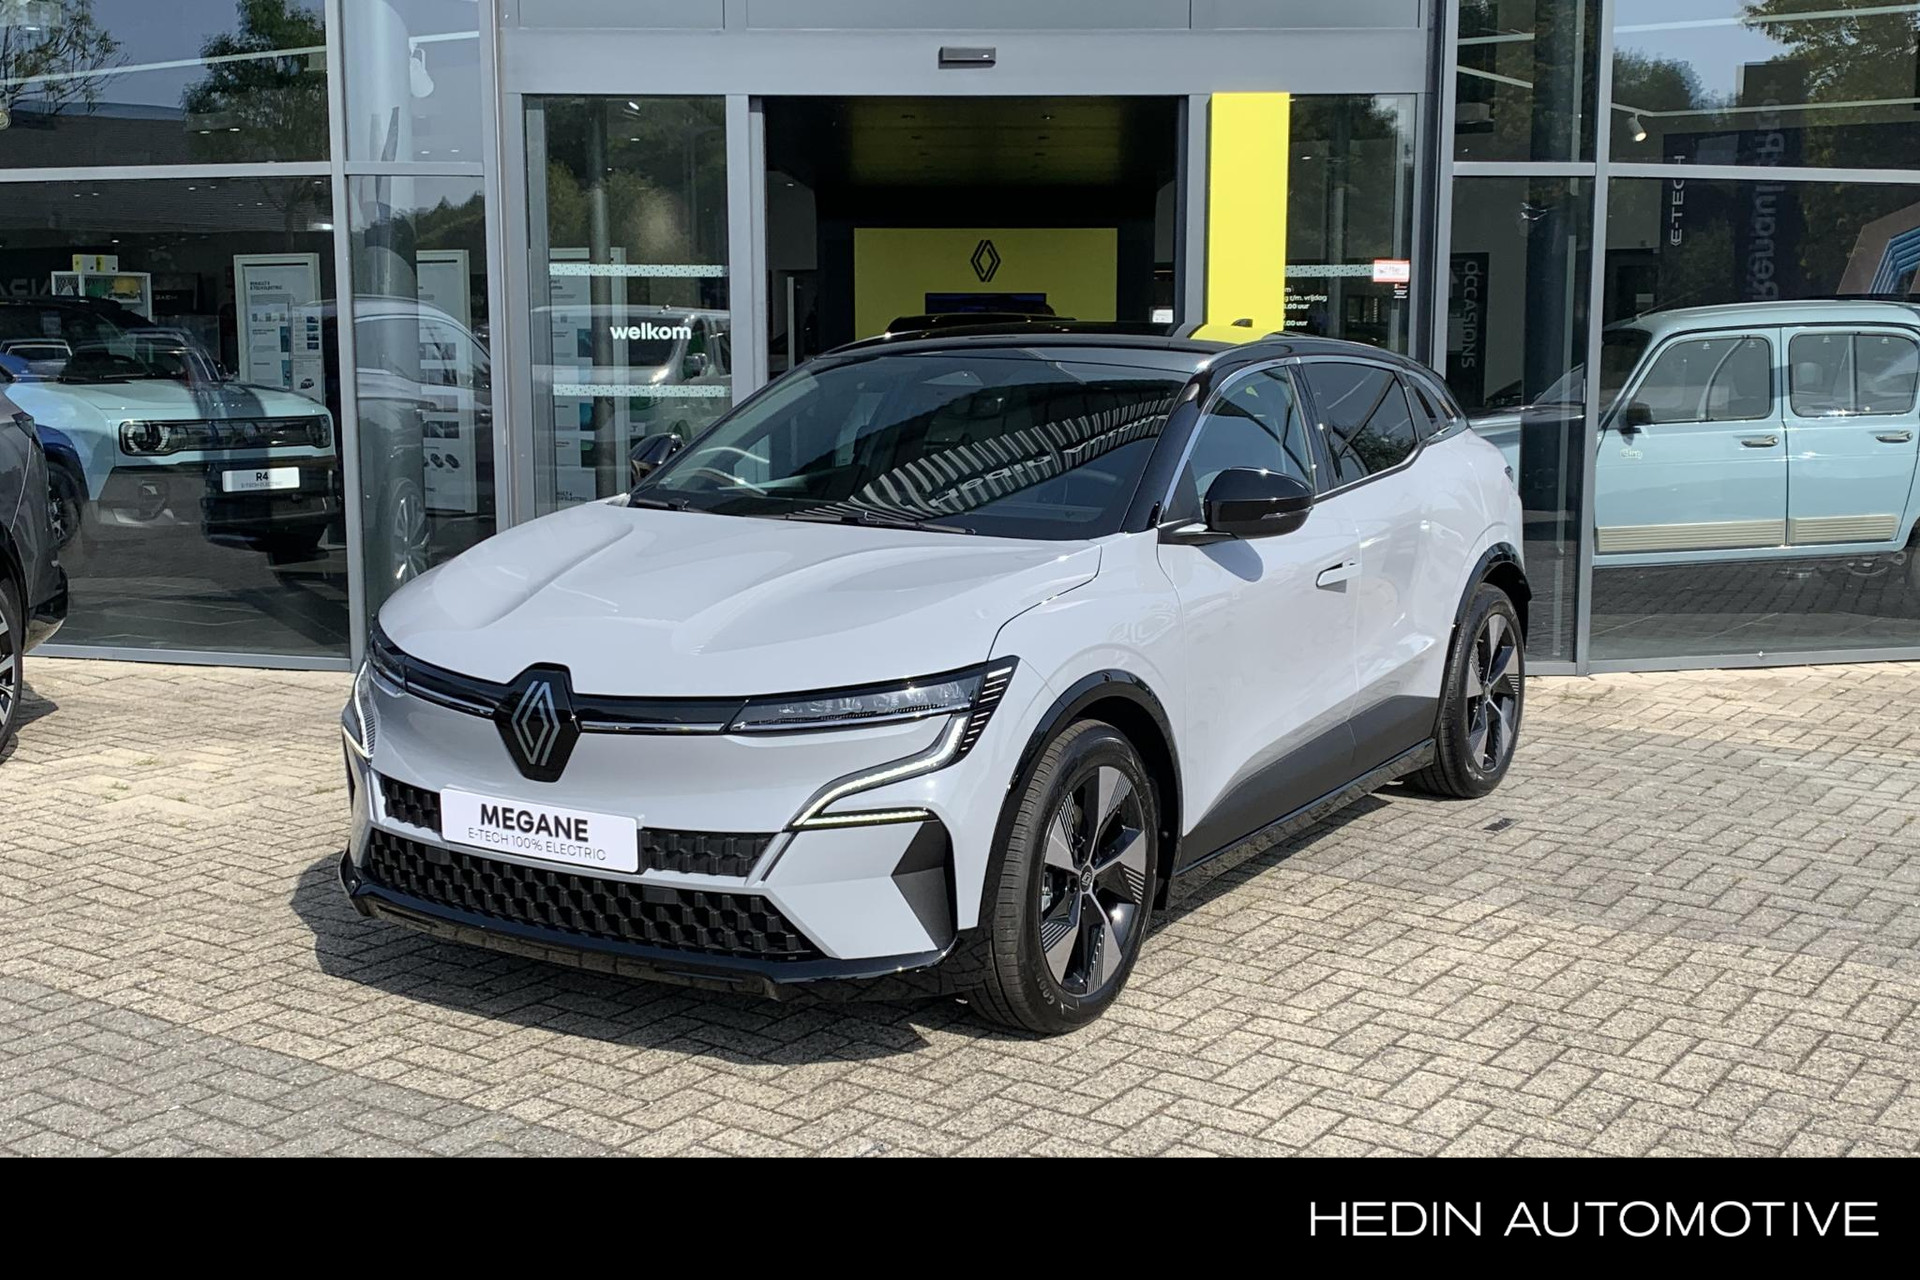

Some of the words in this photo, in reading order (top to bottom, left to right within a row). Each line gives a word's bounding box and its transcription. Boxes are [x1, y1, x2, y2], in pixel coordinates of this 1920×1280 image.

[1303, 294, 1328, 303] vrijdag
[1461, 261, 1478, 368] OCCASIONS
[609, 322, 692, 340] welkom
[255, 471, 269, 481] R4
[480, 803, 589, 842] MEGANE
[468, 827, 509, 846] E-TECH
[511, 835, 543, 851] 100%
[546, 841, 607, 861] ELECTRIC
